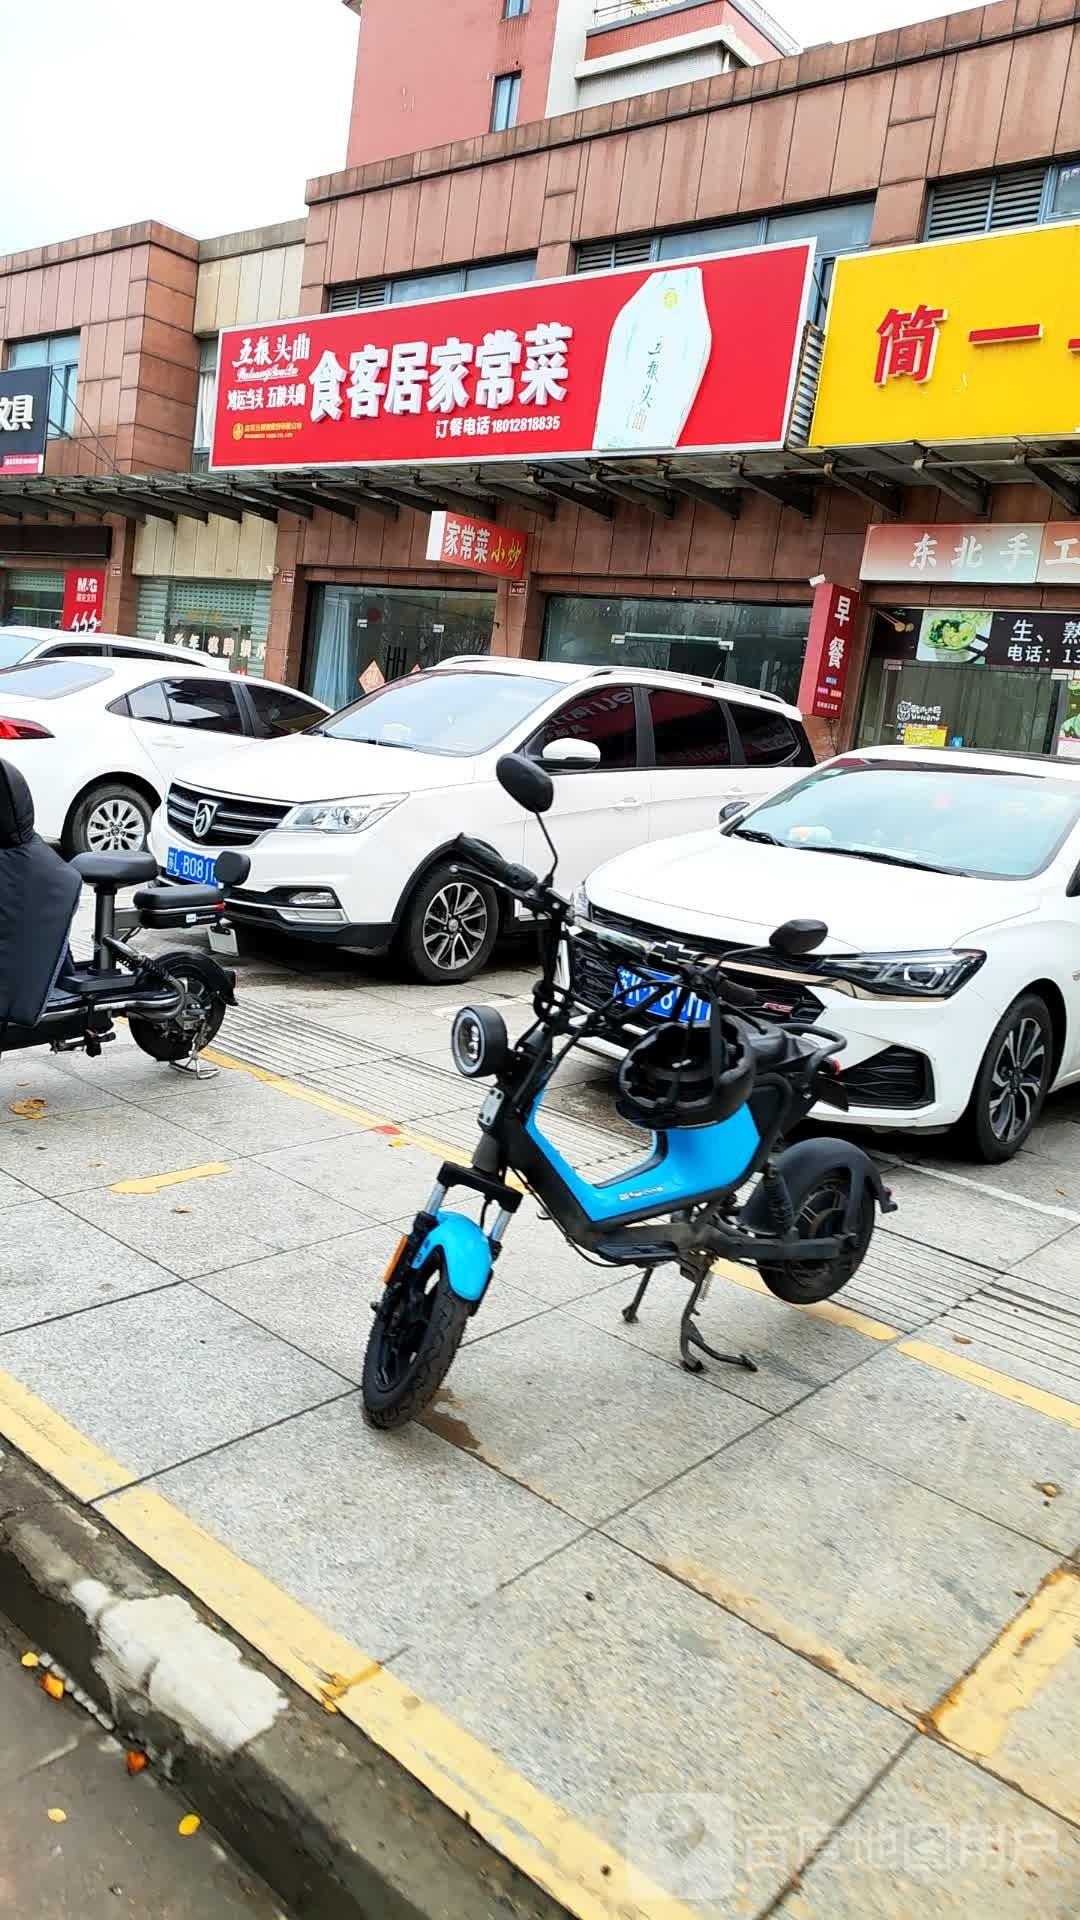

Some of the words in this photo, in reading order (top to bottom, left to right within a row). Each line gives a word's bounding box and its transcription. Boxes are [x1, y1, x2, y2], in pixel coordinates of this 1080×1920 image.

[308, 322, 573, 423] 食客居家常菜
[873, 304, 1080, 387] 简一
[226, 386, 264, 411] 鸿运当头
[265, 383, 306, 409] 五粮头曲
[443, 520, 522, 570] 家常菜小炒
[909, 532, 1080, 571] 东北手工
[828, 595, 852, 670] 早餐
